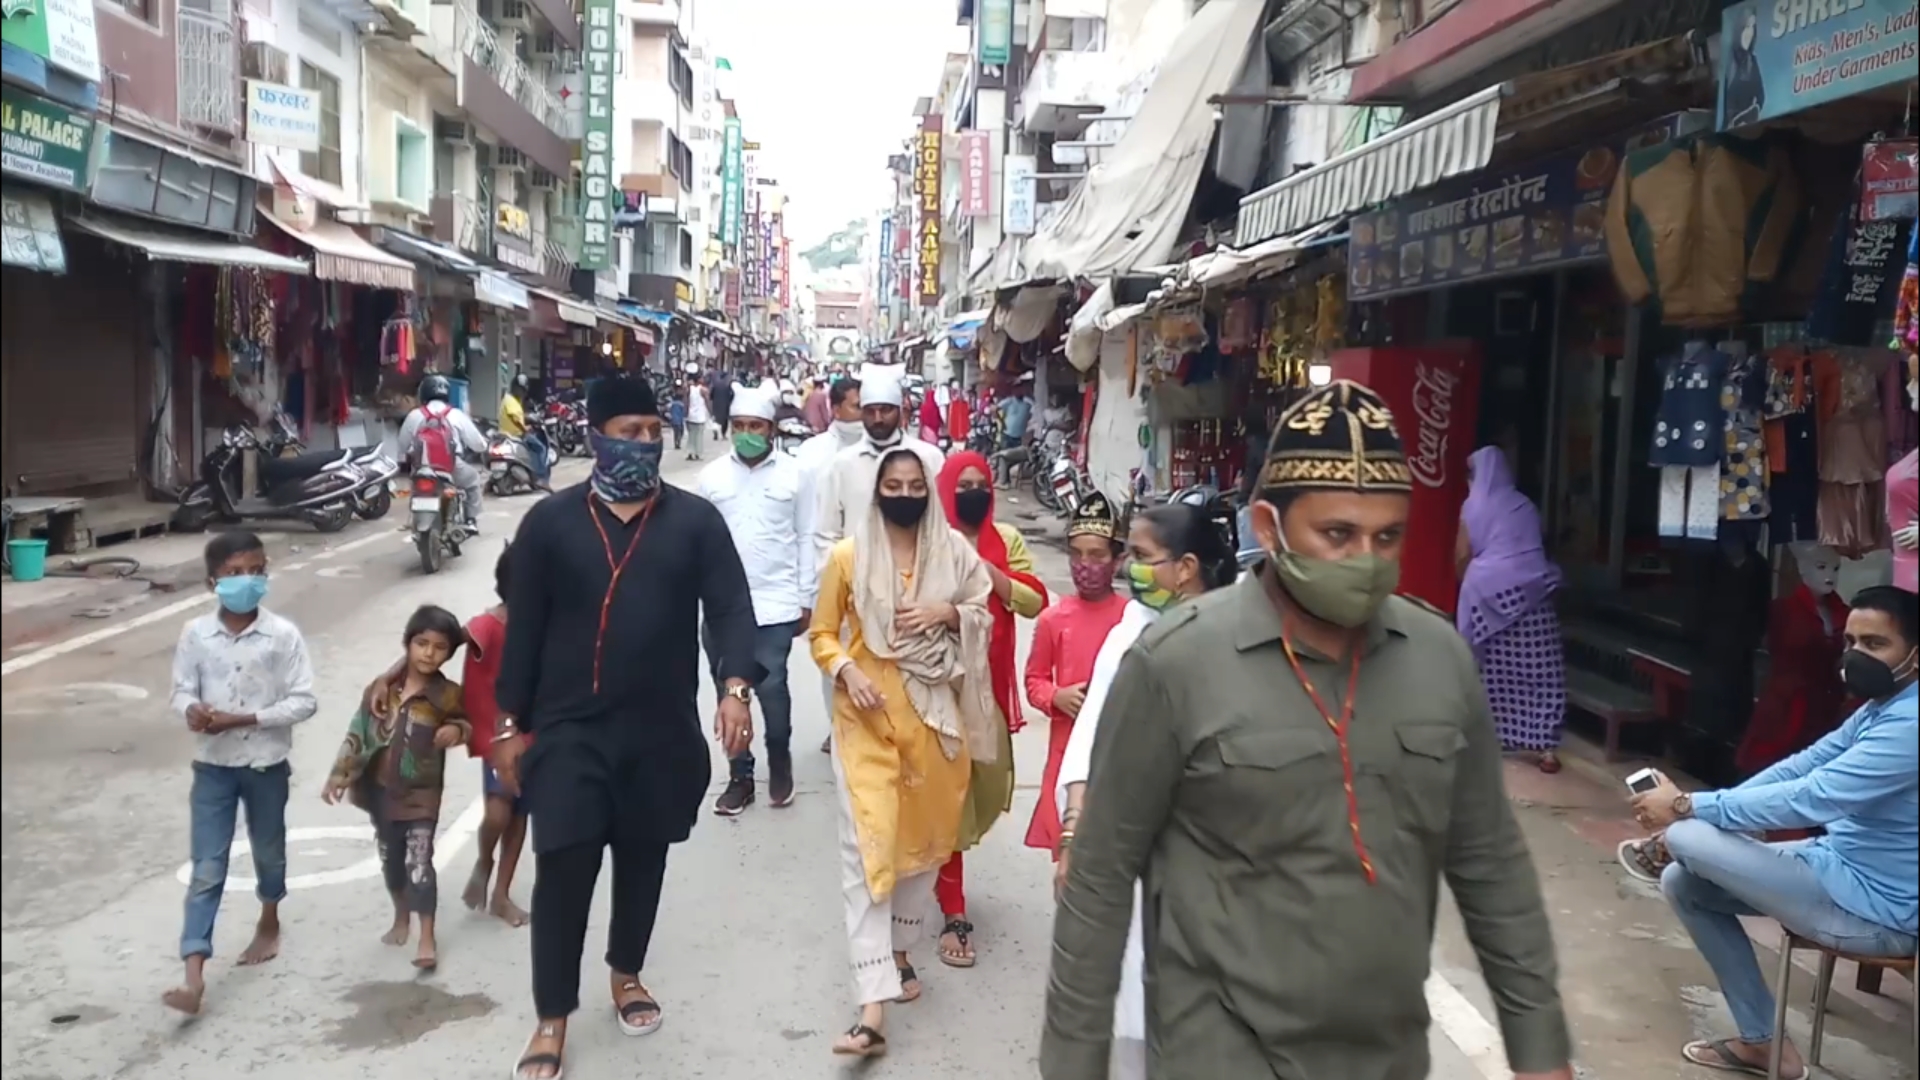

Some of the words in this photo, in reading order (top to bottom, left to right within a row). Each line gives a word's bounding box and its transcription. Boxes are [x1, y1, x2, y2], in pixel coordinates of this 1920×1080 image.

[1771, 0, 1864, 39] SHR
[1794, 41, 1827, 66] Kids,
[1830, 21, 1879, 54] Men's,
[589, 7, 609, 117] HOTEL
[1793, 66, 1837, 94] Under
[1840, 41, 1915, 79] Garments
[2, 101, 16, 131] L
[20, 109, 83, 152] PALACE
[585, 130, 607, 243] SAGAR
[923, 131, 940, 211] HOTEL
[745, 214, 754, 287] JANNAT
[921, 218, 939, 295] AAMIR
[1408, 360, 1460, 487] Coca-Cola
